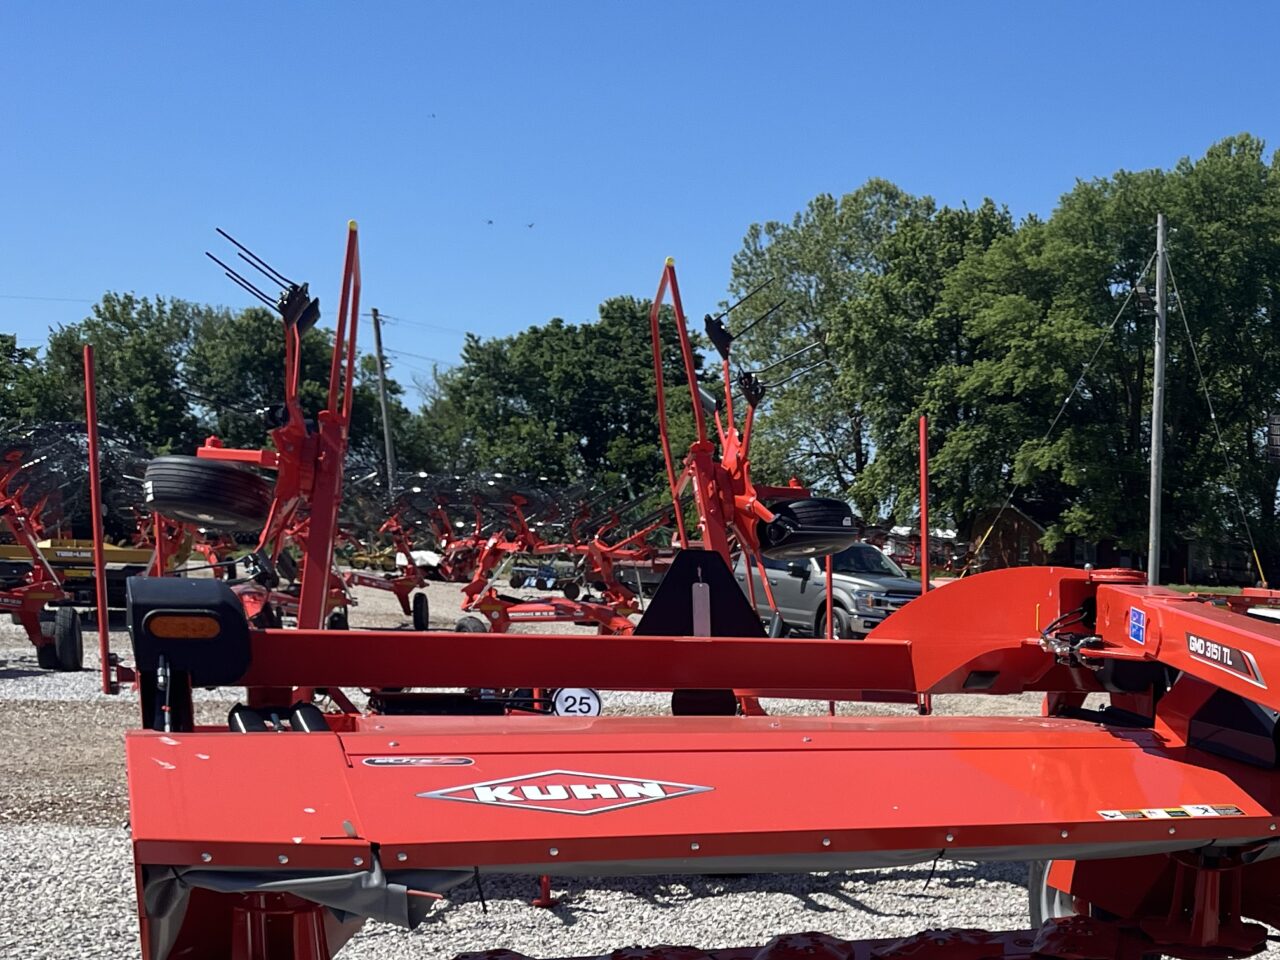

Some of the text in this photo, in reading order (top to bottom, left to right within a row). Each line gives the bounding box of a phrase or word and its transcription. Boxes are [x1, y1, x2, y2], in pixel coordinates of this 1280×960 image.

[1189, 635, 1205, 654] GMD
[1222, 647, 1233, 666] TL
[563, 696, 591, 713] 25
[473, 782, 667, 802] KUHN
